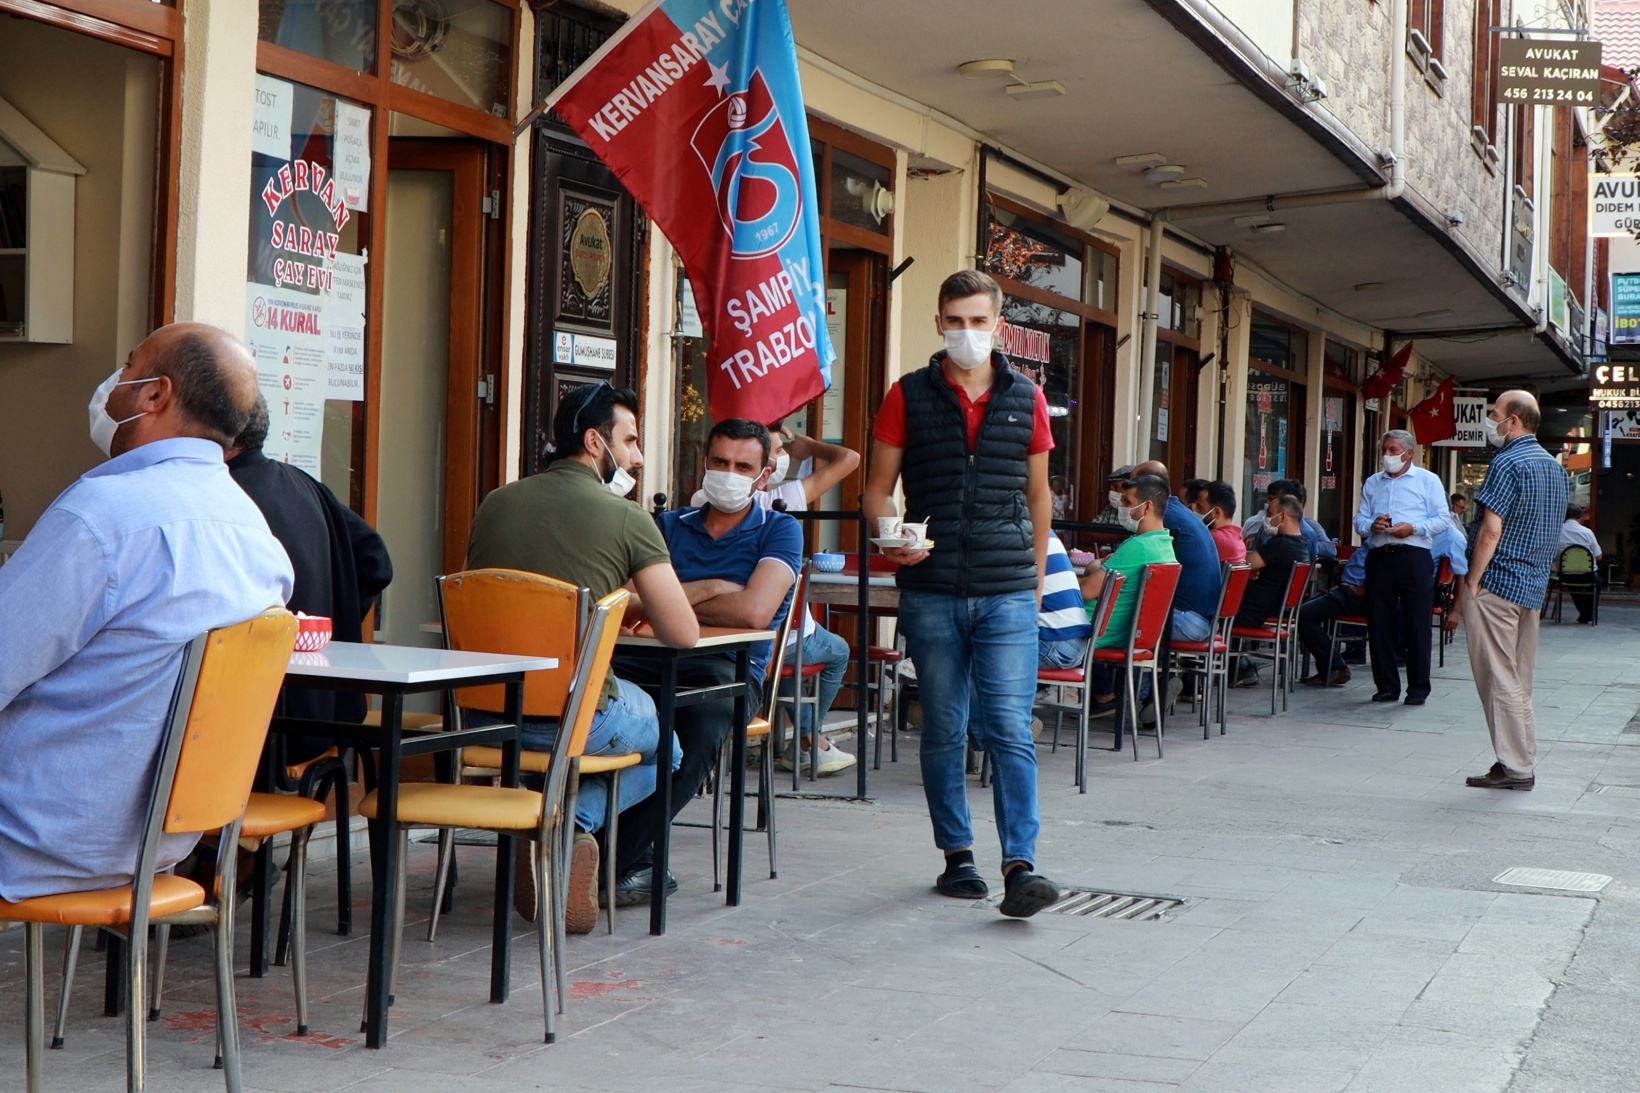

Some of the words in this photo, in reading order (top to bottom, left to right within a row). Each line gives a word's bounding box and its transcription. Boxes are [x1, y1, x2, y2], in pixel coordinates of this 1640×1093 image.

[1525, 48, 1579, 60] AVUKAT
[588, 10, 726, 142] KERVANSARAY
[1501, 66, 1539, 78] SEVAL
[1543, 68, 1599, 80] KAÇIRAN
[255, 88, 277, 108] TOST
[1504, 88, 1528, 99] 456
[1533, 88, 1554, 100] 213
[1557, 90, 1573, 101] 24
[1576, 91, 1594, 102] 04
[262, 160, 350, 232] KERVAN
[1594, 181, 1640, 198] AVU
[271, 220, 339, 260] SARAY
[755, 222, 779, 242] 1967
[580, 233, 603, 250] Avukat
[274, 257, 305, 287] ÇAY
[306, 264, 334, 292] EVİ
[267, 306, 278, 330] 14
[280, 308, 321, 336] KURAL
[574, 342, 601, 361] GÜMÜŞHANE
[1593, 388, 1626, 397] HUKUK
[1598, 400, 1640, 408] 0456213
[1458, 428, 1483, 441] DEMİR
